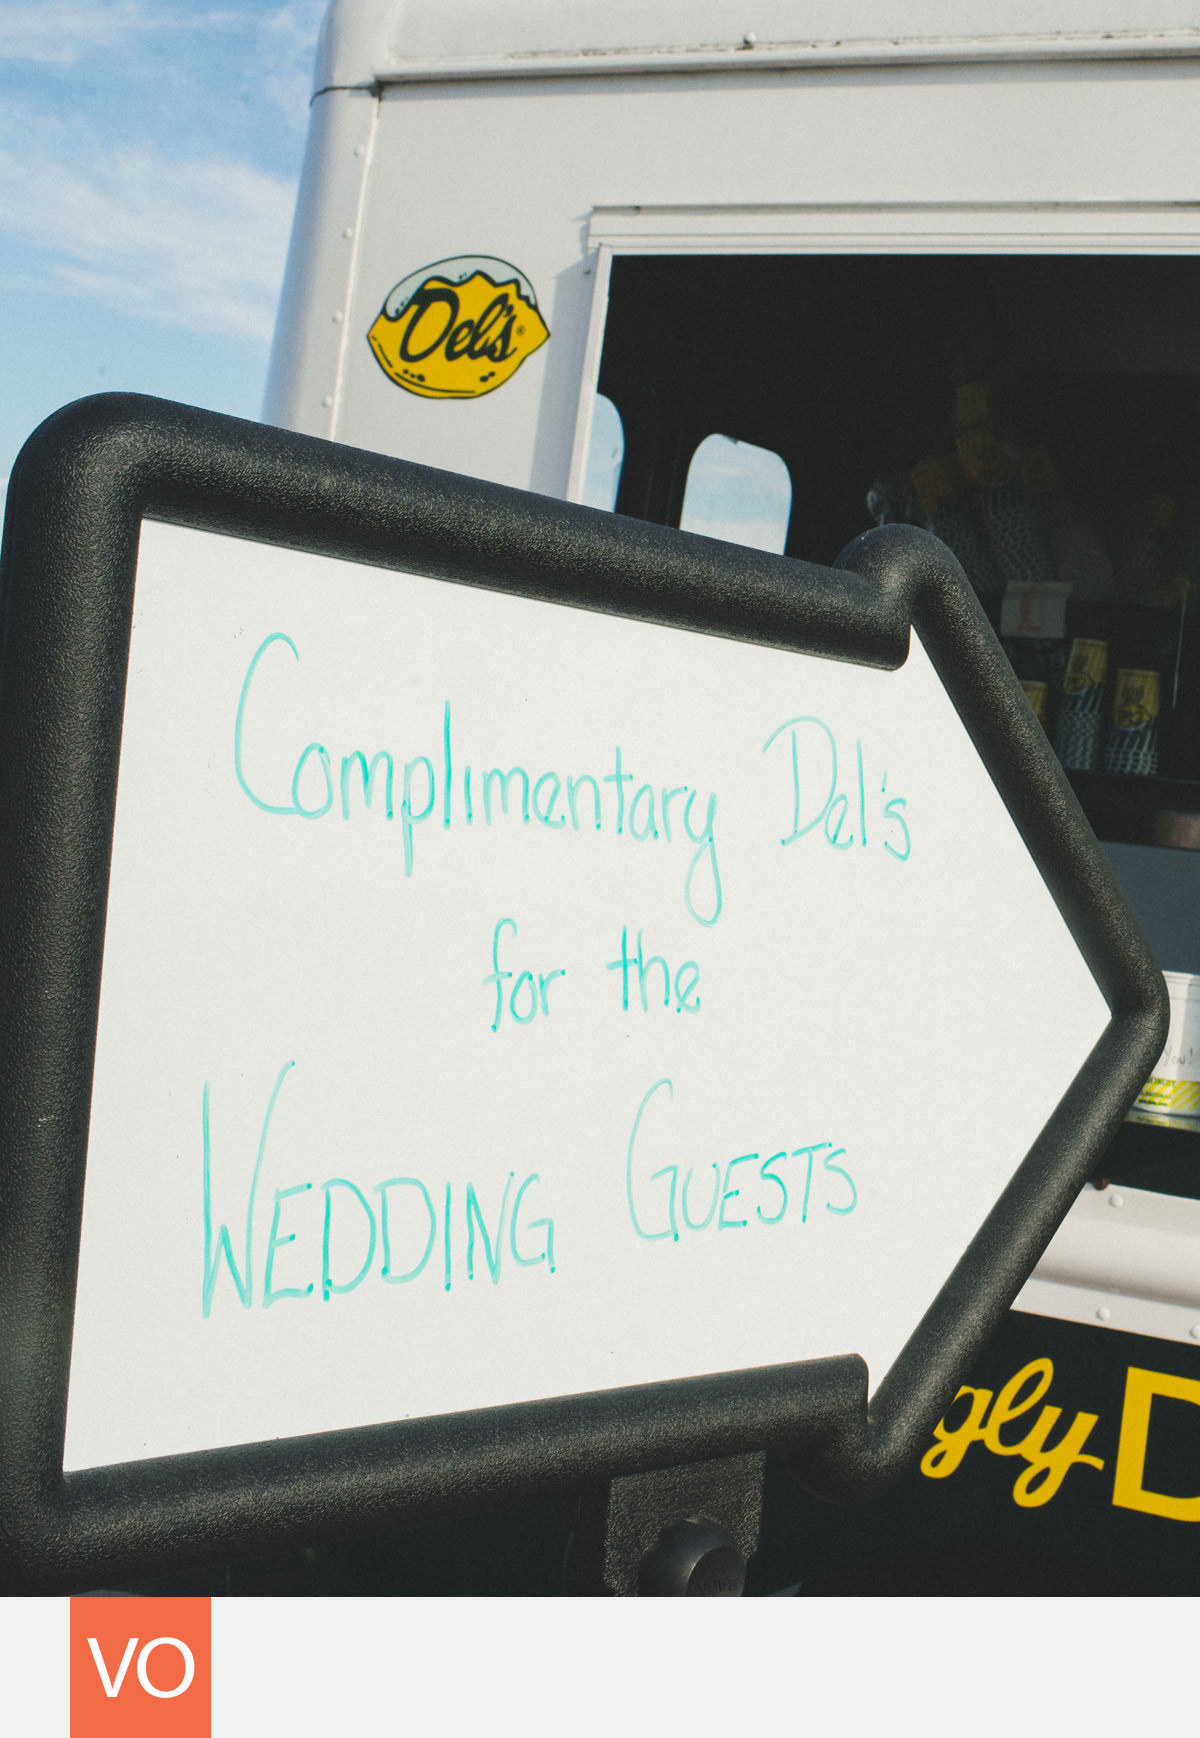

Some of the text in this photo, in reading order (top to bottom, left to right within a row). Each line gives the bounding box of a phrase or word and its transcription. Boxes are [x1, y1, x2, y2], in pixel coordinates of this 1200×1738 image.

[234, 632, 912, 928] Complimentary Del's
[483, 918, 700, 1033] for the
[202, 1060, 858, 1319] WEDDING GUESTS
